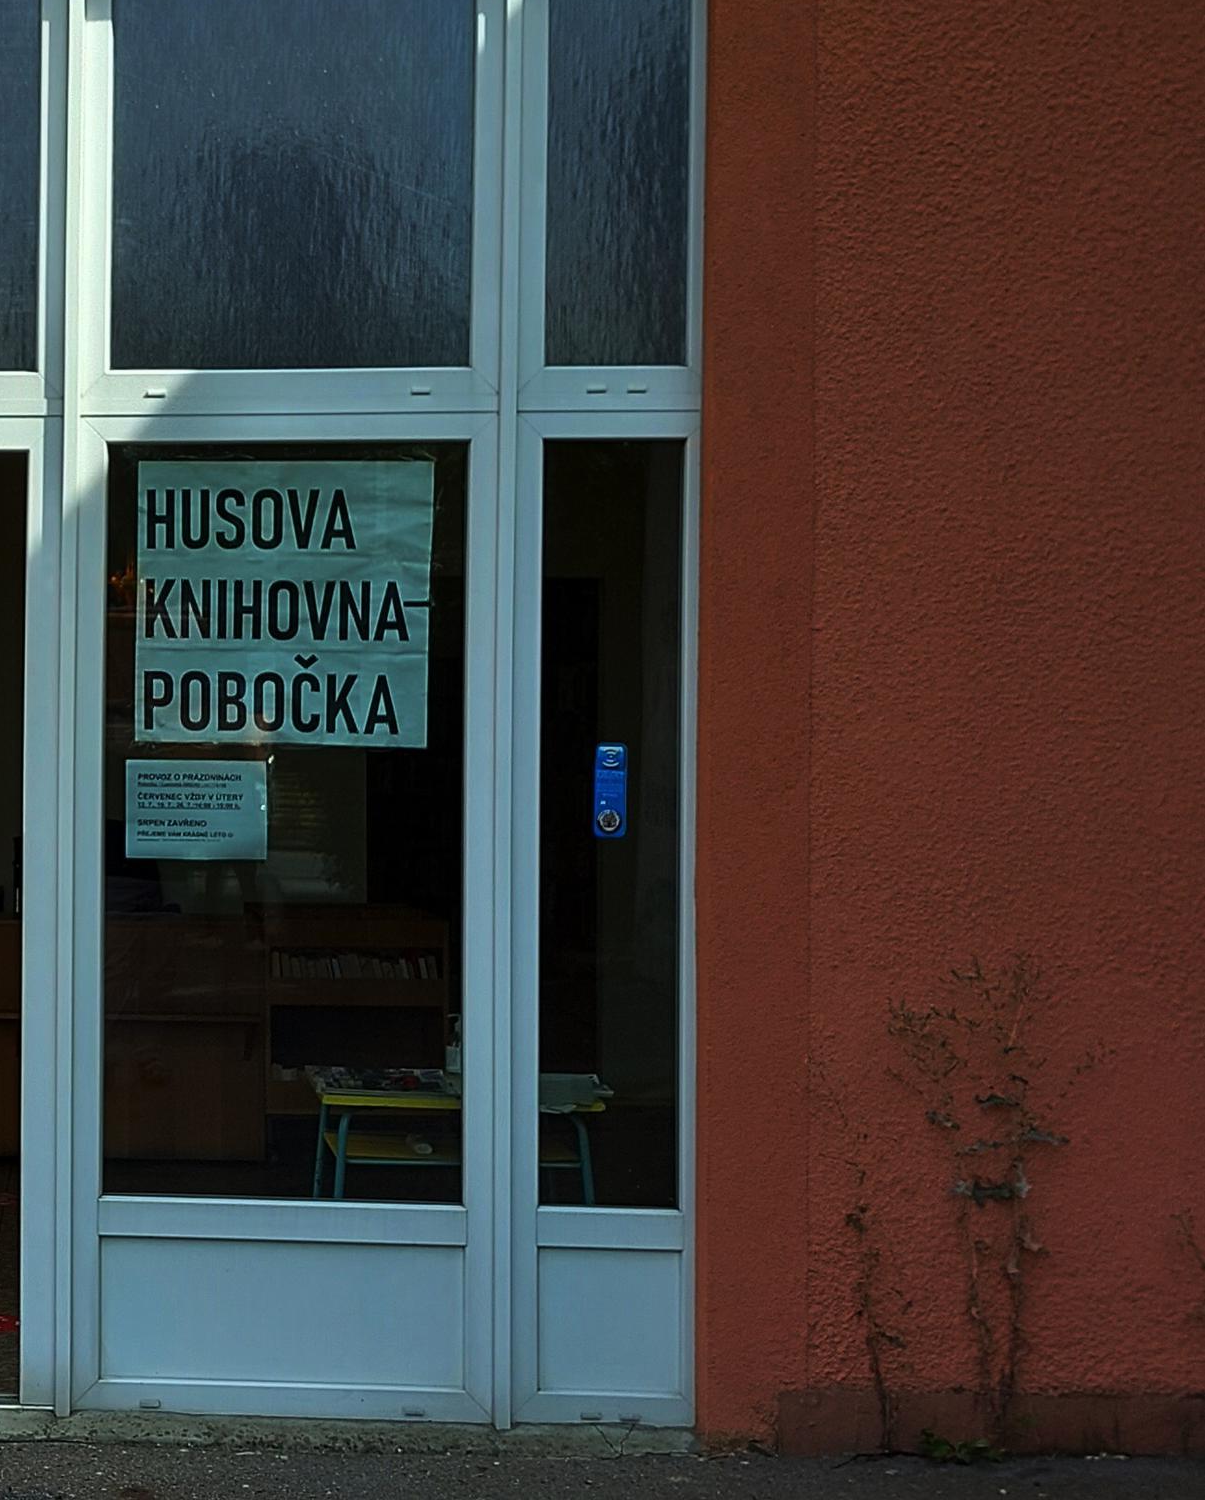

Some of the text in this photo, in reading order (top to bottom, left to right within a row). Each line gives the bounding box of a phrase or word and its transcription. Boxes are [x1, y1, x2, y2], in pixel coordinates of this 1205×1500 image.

[146, 488, 357, 550] HUSOVA
[143, 653, 400, 736] POBOČKA
[138, 773, 172, 781] PROVOZ
[137, 791, 183, 800] ČERVENEC
[137, 818, 208, 828] SRPEN ZAVŘENO
